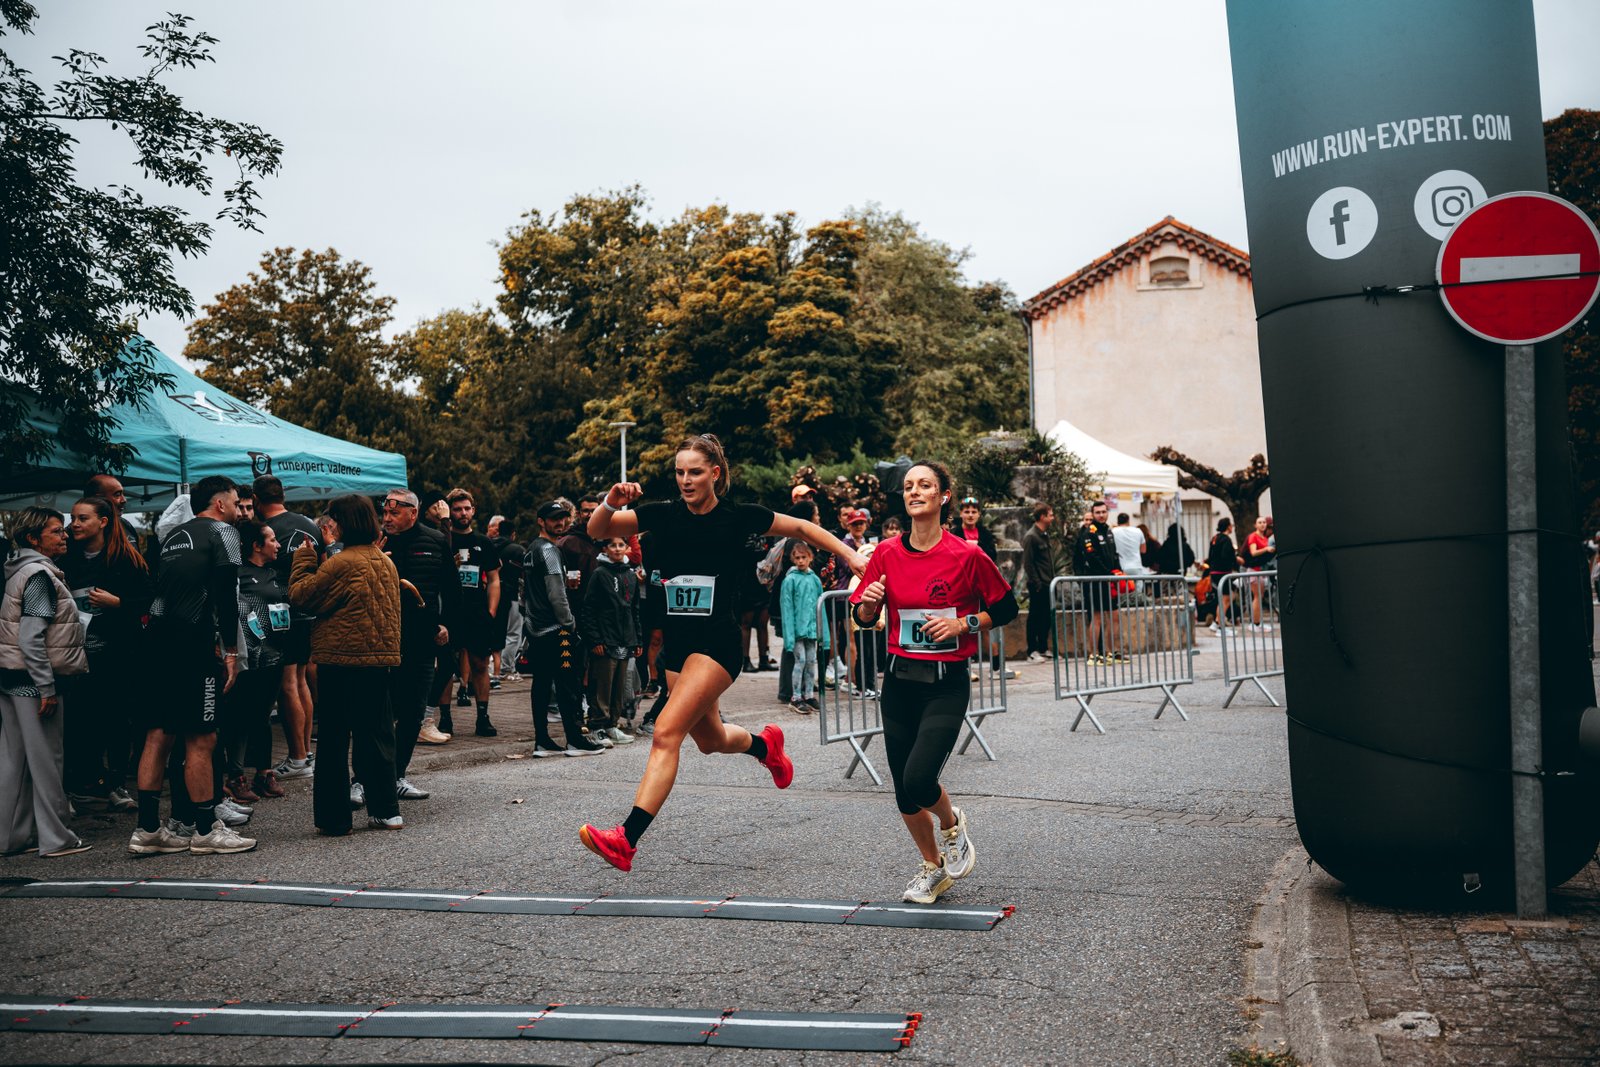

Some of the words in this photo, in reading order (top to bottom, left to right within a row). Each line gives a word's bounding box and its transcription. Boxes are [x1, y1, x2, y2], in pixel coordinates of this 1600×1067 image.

[1472, 114, 1511, 141] COM
[676, 588, 701, 607] 617
[204, 677, 216, 721] SHARKS
